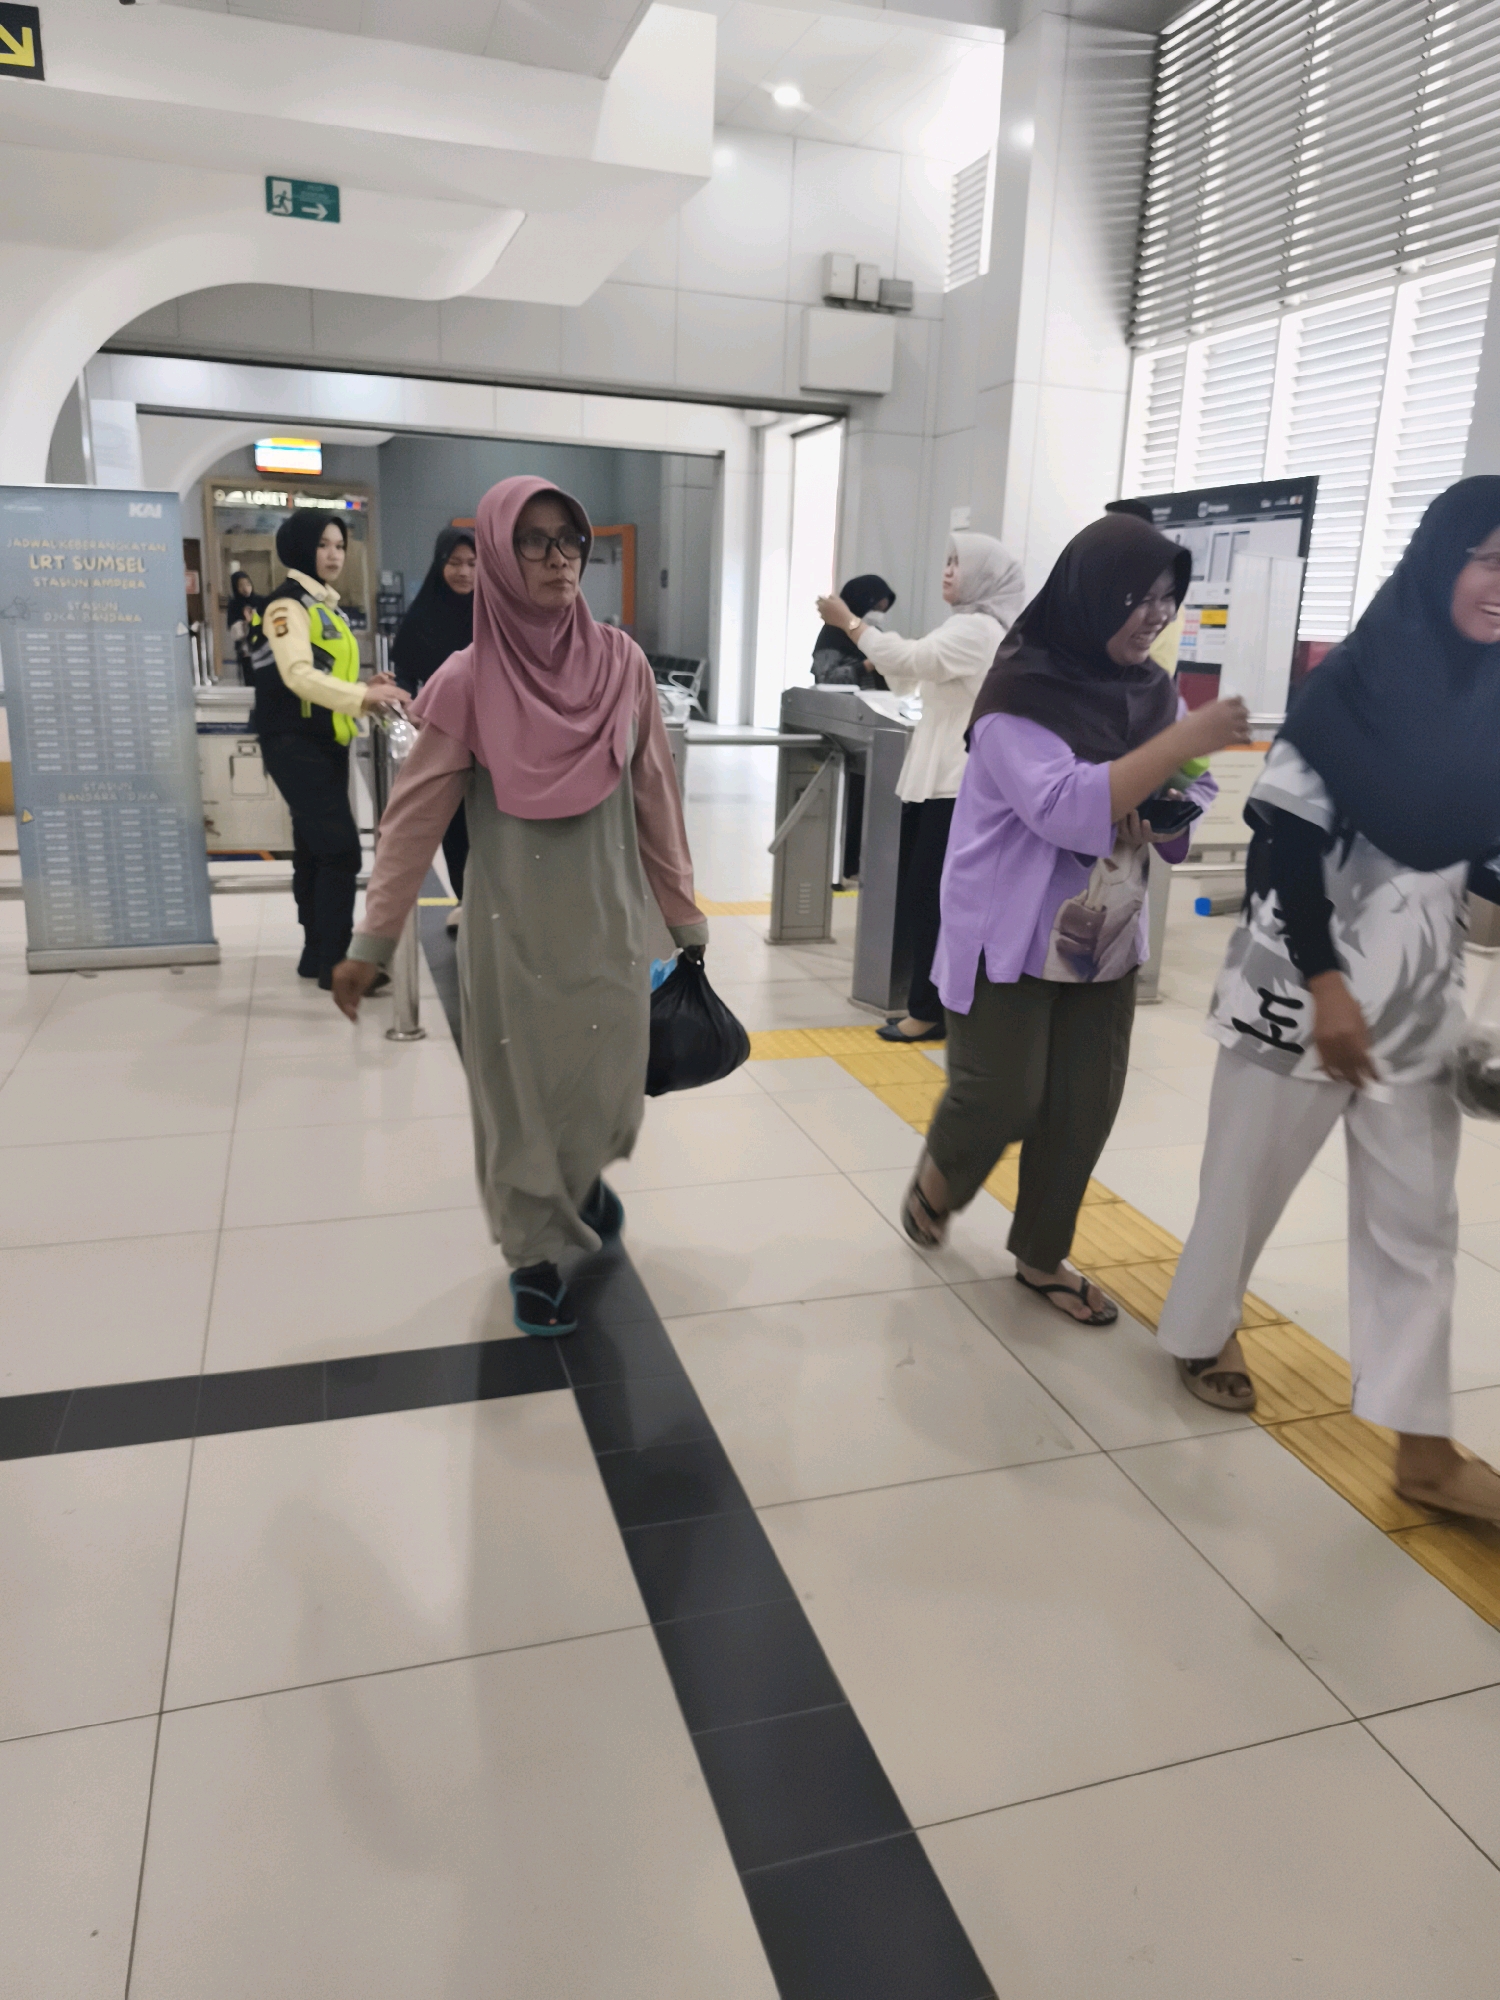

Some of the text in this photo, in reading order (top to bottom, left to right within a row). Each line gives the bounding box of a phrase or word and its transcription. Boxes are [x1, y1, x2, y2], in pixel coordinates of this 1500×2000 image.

[128, 502, 163, 519] KAI
[29, 554, 147, 573] LRT SUMSEL
[33, 577, 146, 590] STASIUN AMPERA
